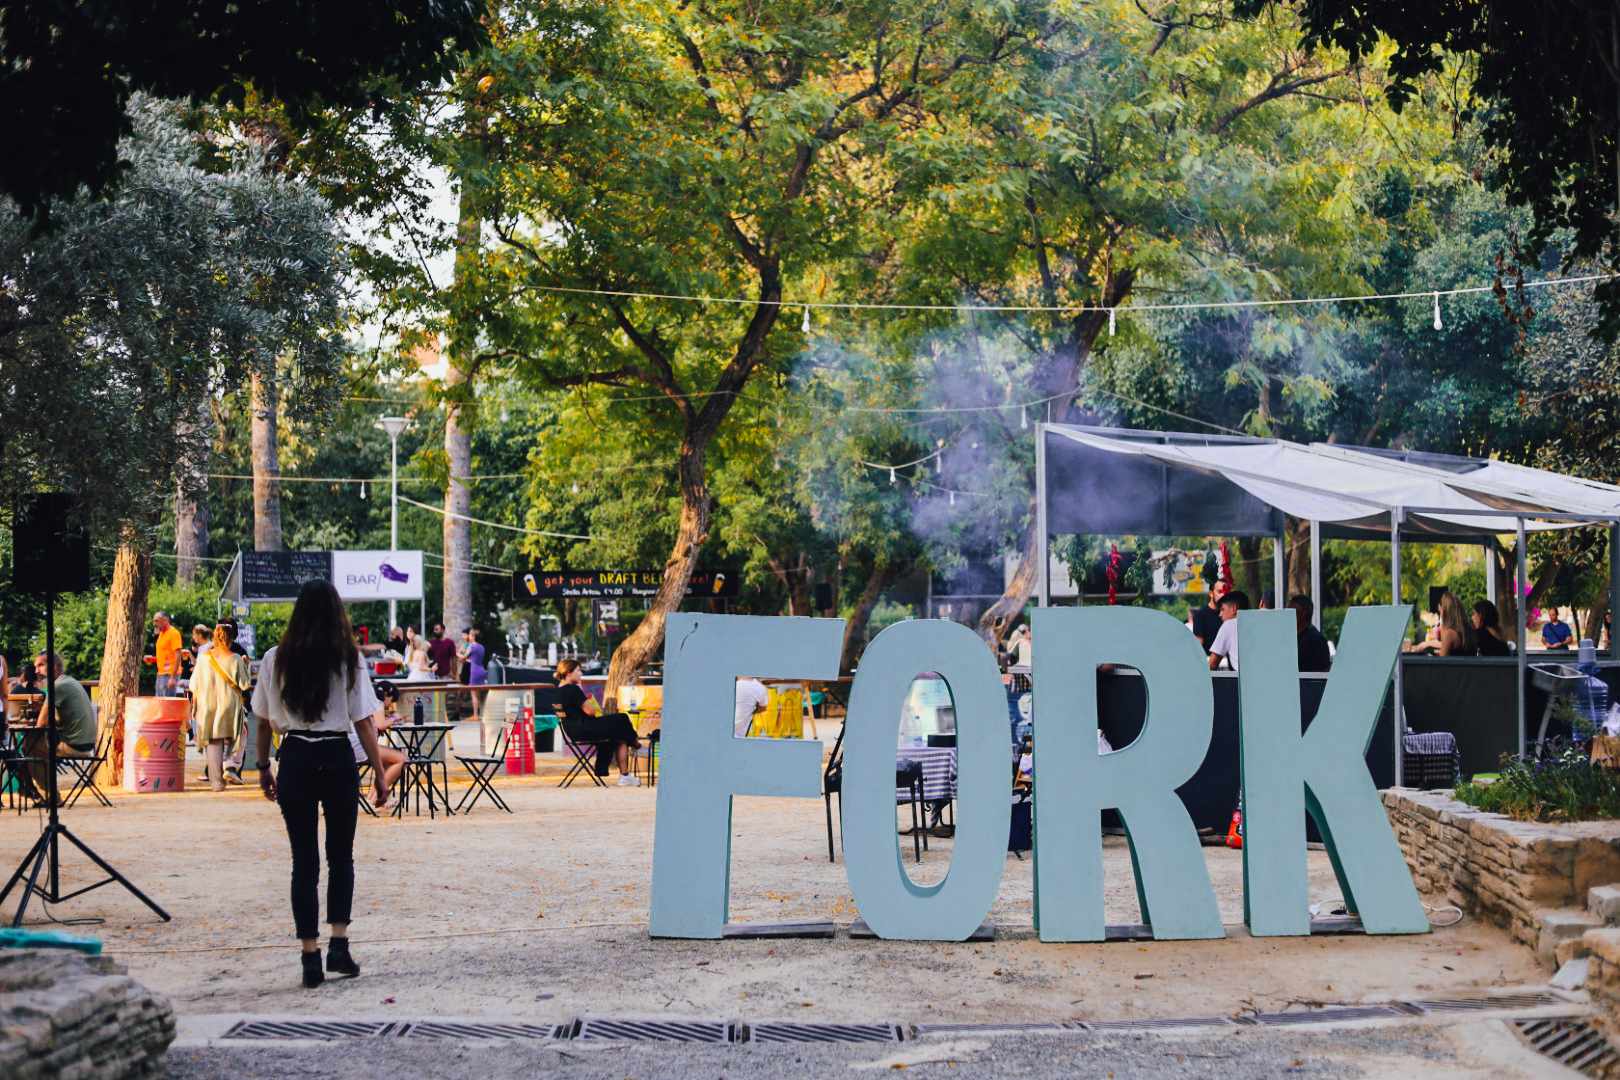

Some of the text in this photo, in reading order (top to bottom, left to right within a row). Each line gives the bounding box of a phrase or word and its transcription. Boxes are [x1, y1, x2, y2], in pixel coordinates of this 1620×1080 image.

[346, 574, 377, 585] BAR
[544, 575, 564, 588] get
[569, 576, 593, 588] your
[599, 573, 637, 585] DRAFT
[643, 573, 665, 585] BEE
[649, 605, 1433, 942] FORK
